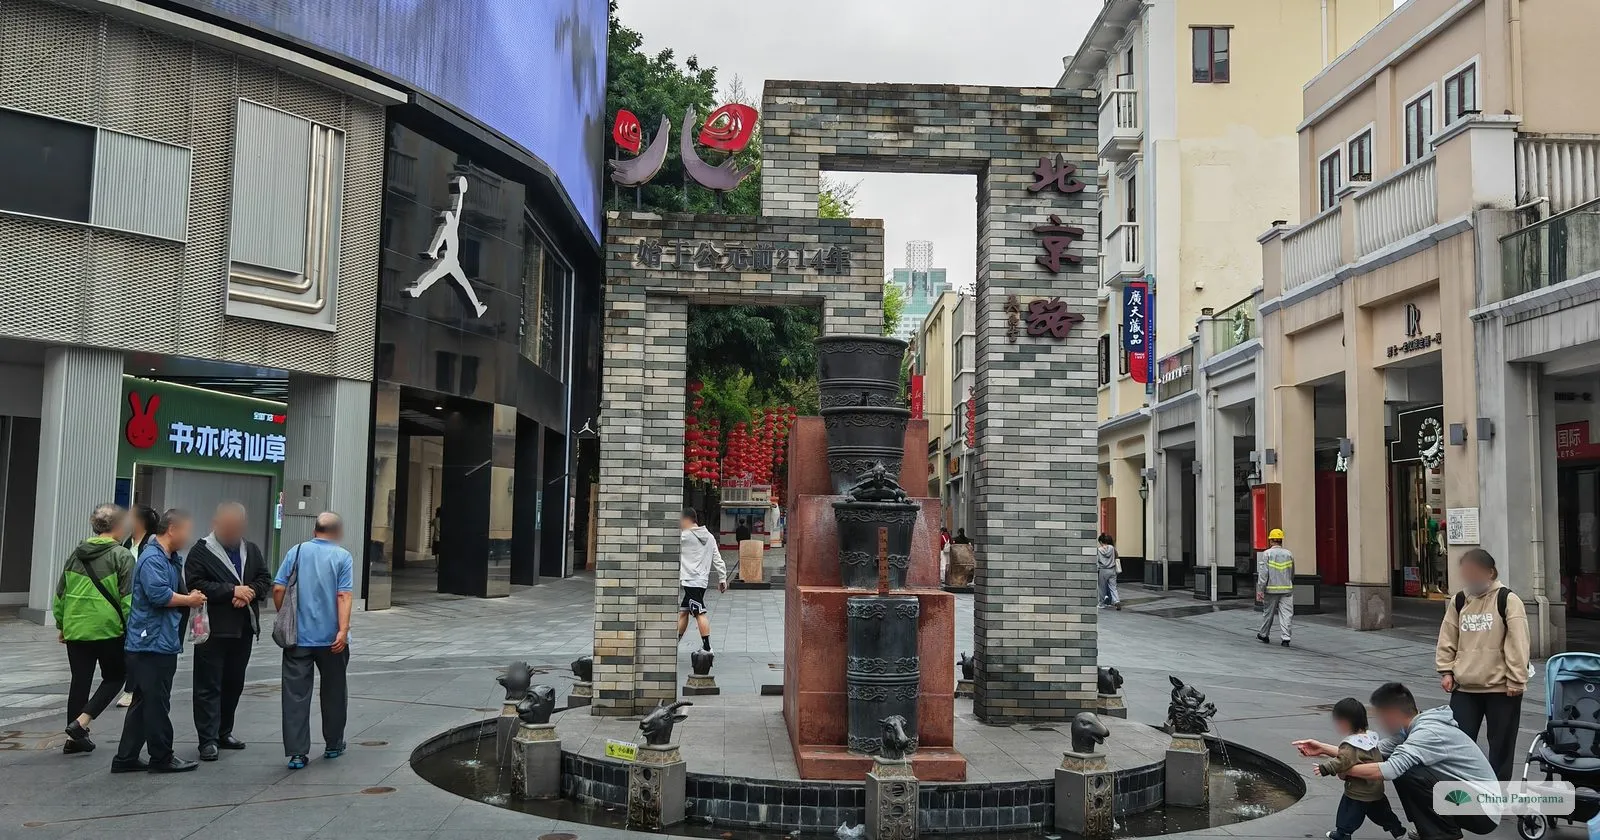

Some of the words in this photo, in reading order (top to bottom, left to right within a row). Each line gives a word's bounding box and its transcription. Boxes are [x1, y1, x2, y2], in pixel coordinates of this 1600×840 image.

[636, 239, 851, 273] 始于公元前214年
[1027, 152, 1086, 341] 北京路
[1128, 290, 1144, 345] 廣天藏品
[169, 422, 286, 462] 书亦烧仙草
